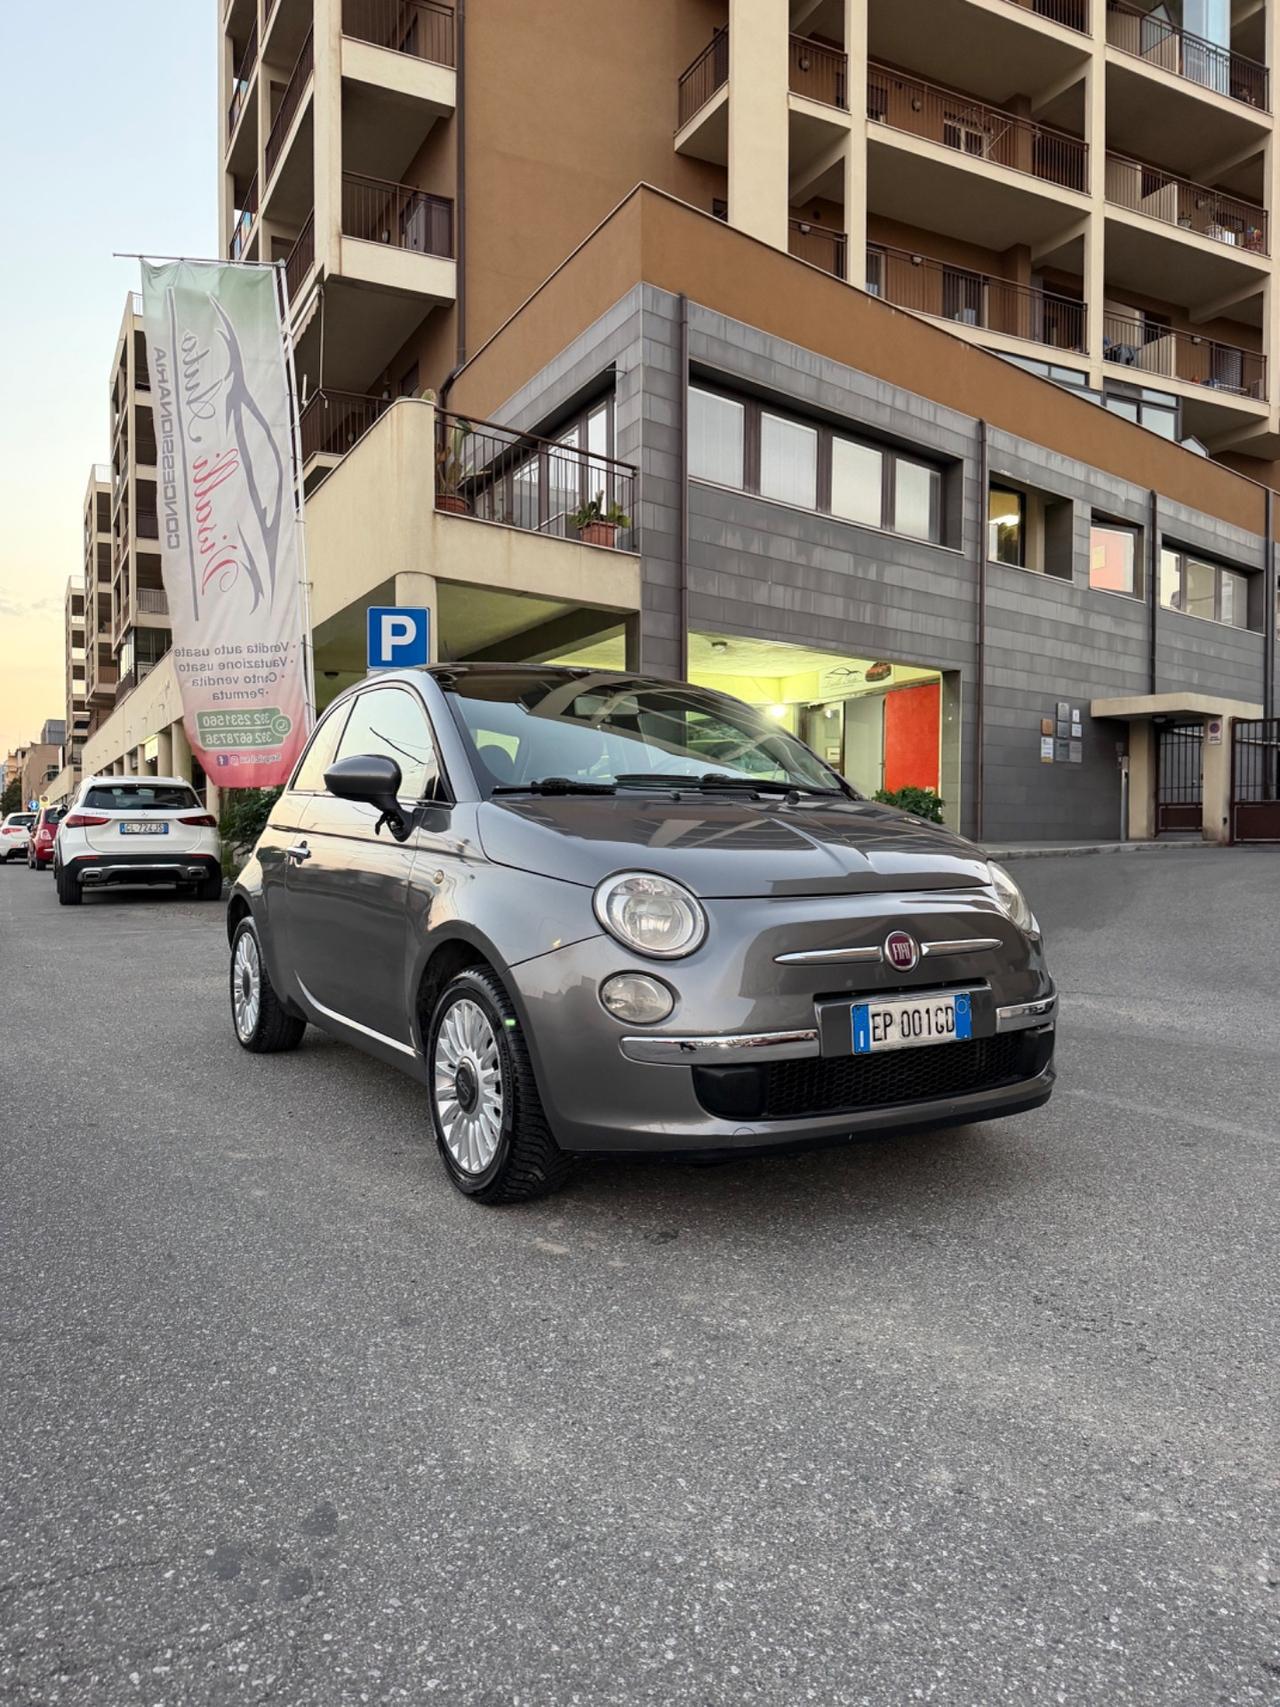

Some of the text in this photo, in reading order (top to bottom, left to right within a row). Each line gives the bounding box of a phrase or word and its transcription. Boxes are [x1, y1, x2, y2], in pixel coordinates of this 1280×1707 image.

[381, 615, 417, 661] P
[891, 942, 911, 961] FIAT
[871, 1012, 893, 1042] EP
